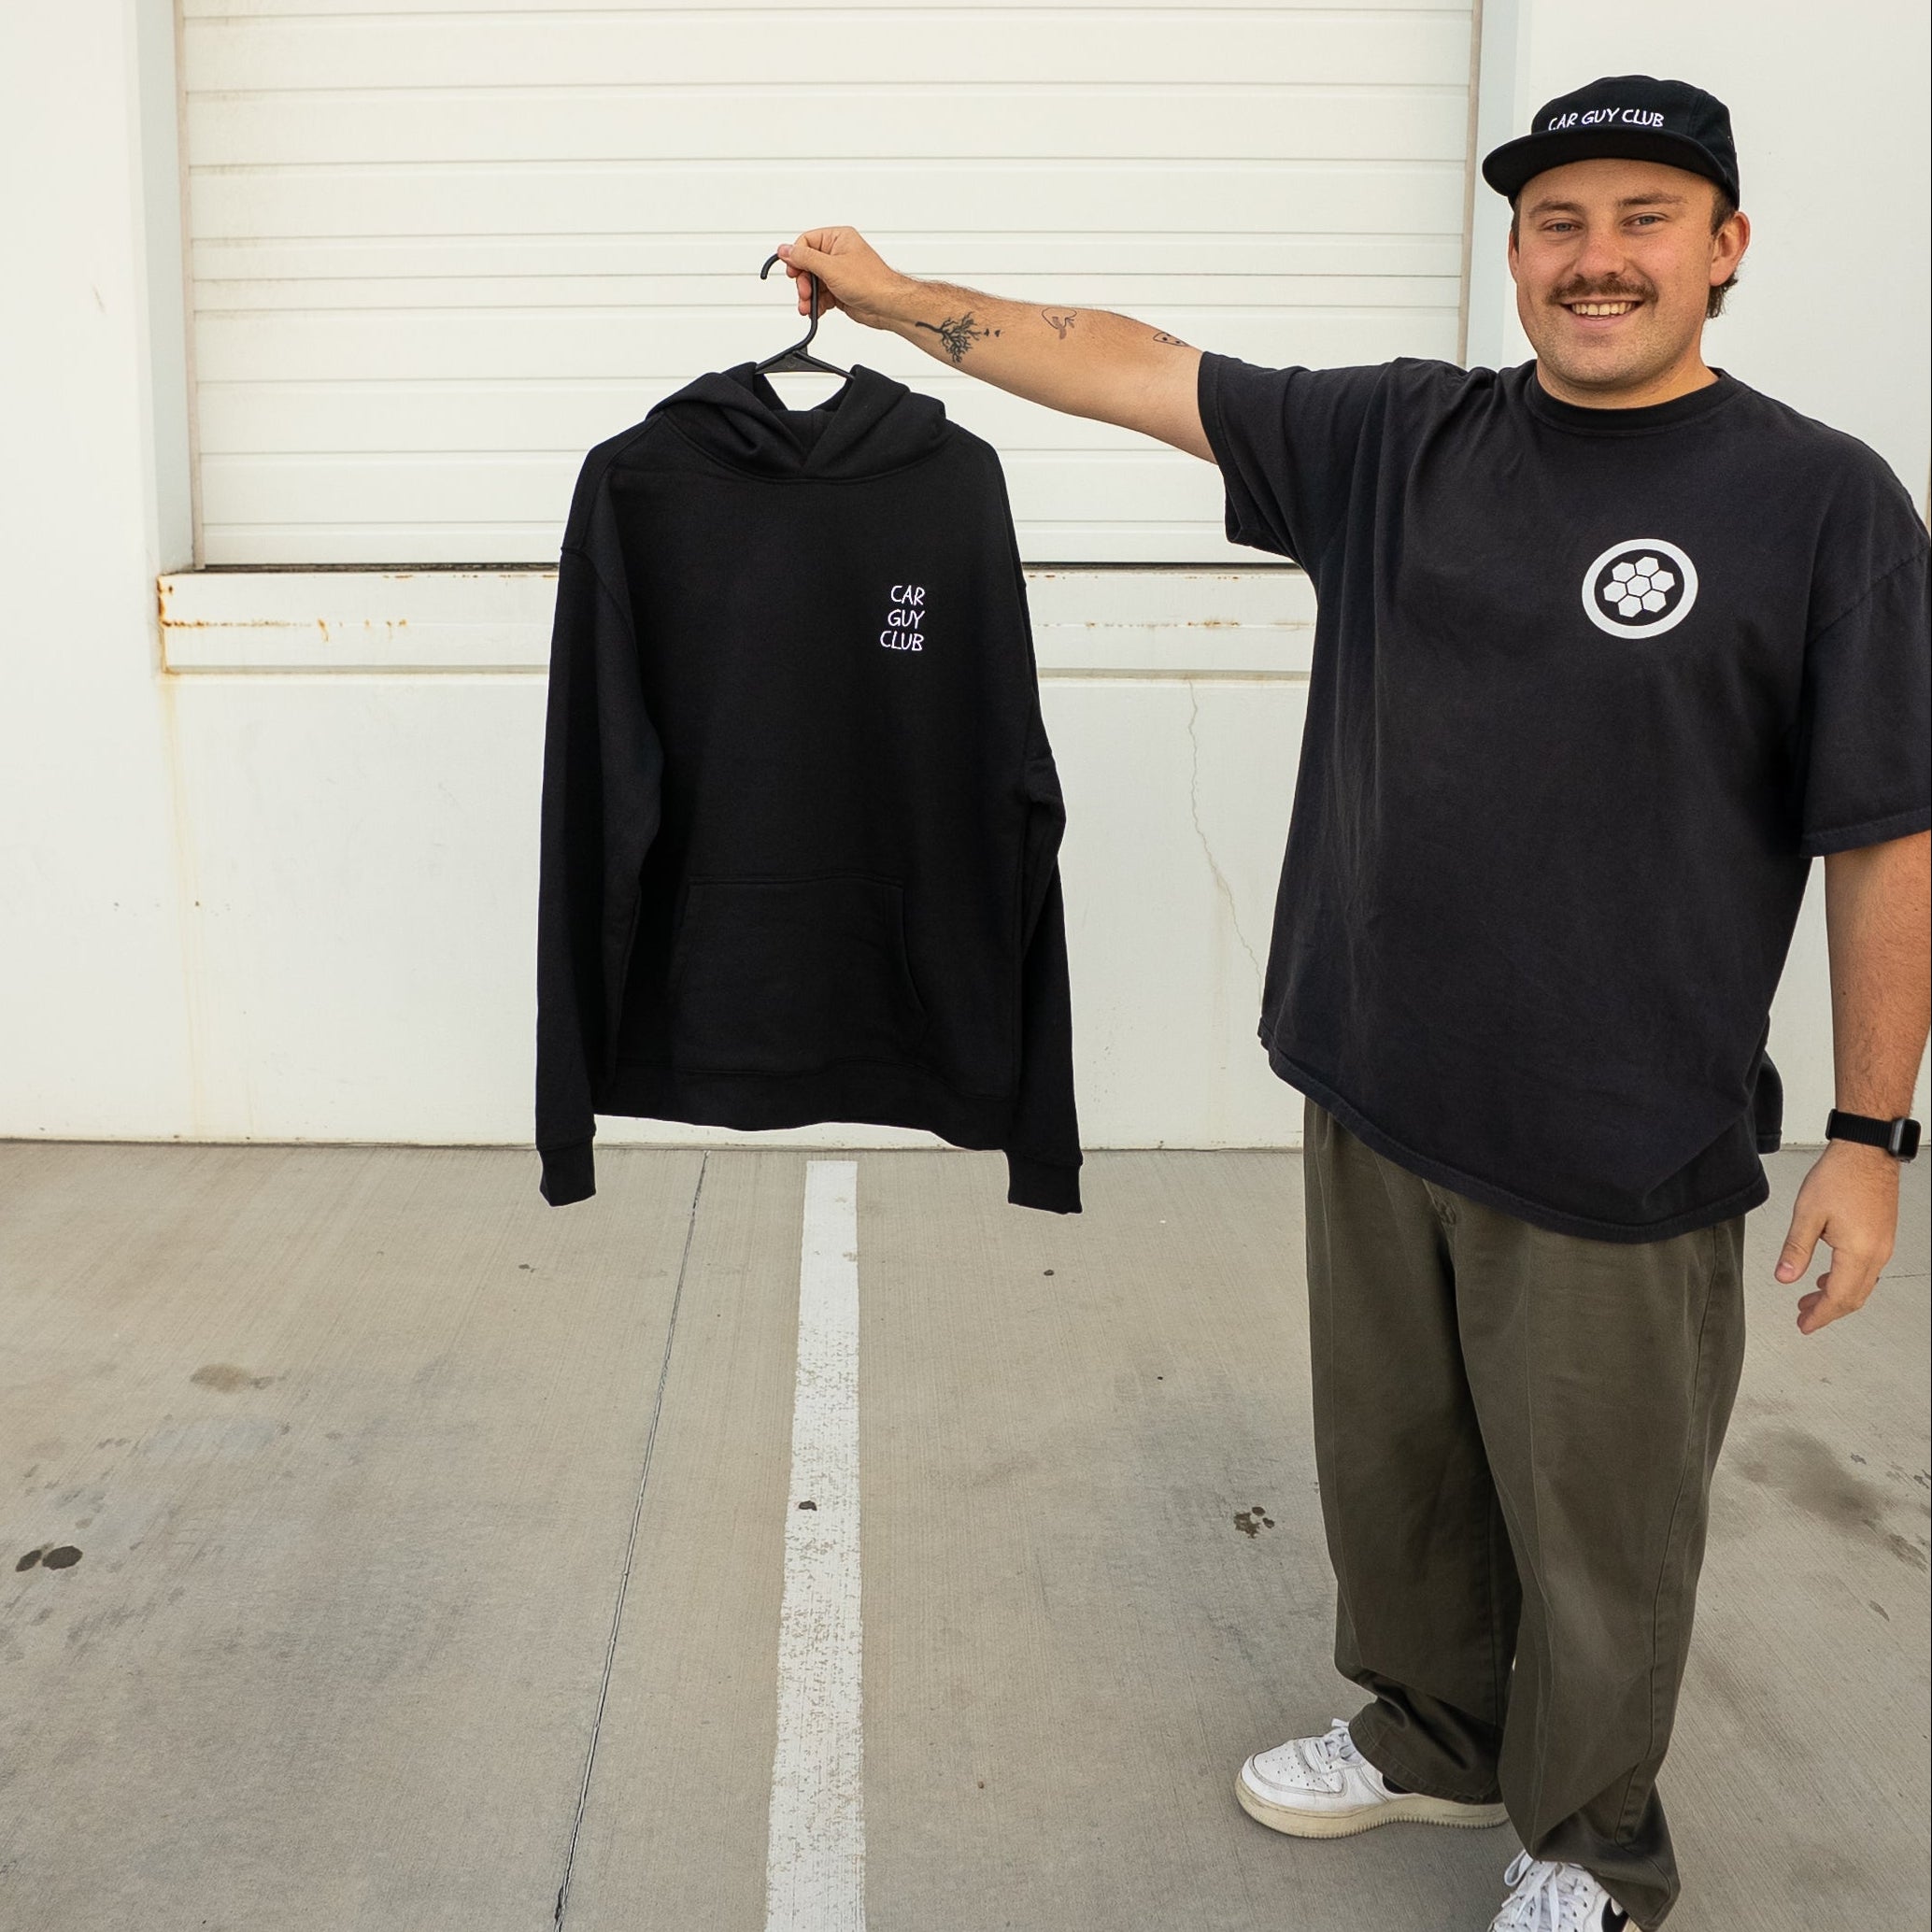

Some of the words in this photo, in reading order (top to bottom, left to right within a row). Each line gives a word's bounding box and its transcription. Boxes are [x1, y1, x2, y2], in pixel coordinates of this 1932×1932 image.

[1548, 113, 1578, 131] CAR
[1582, 107, 1620, 125] GUY
[1622, 109, 1664, 127] CLUB
[891, 585, 925, 605] CAR
[888, 609, 925, 629] GUY
[880, 631, 925, 651] CLUB
